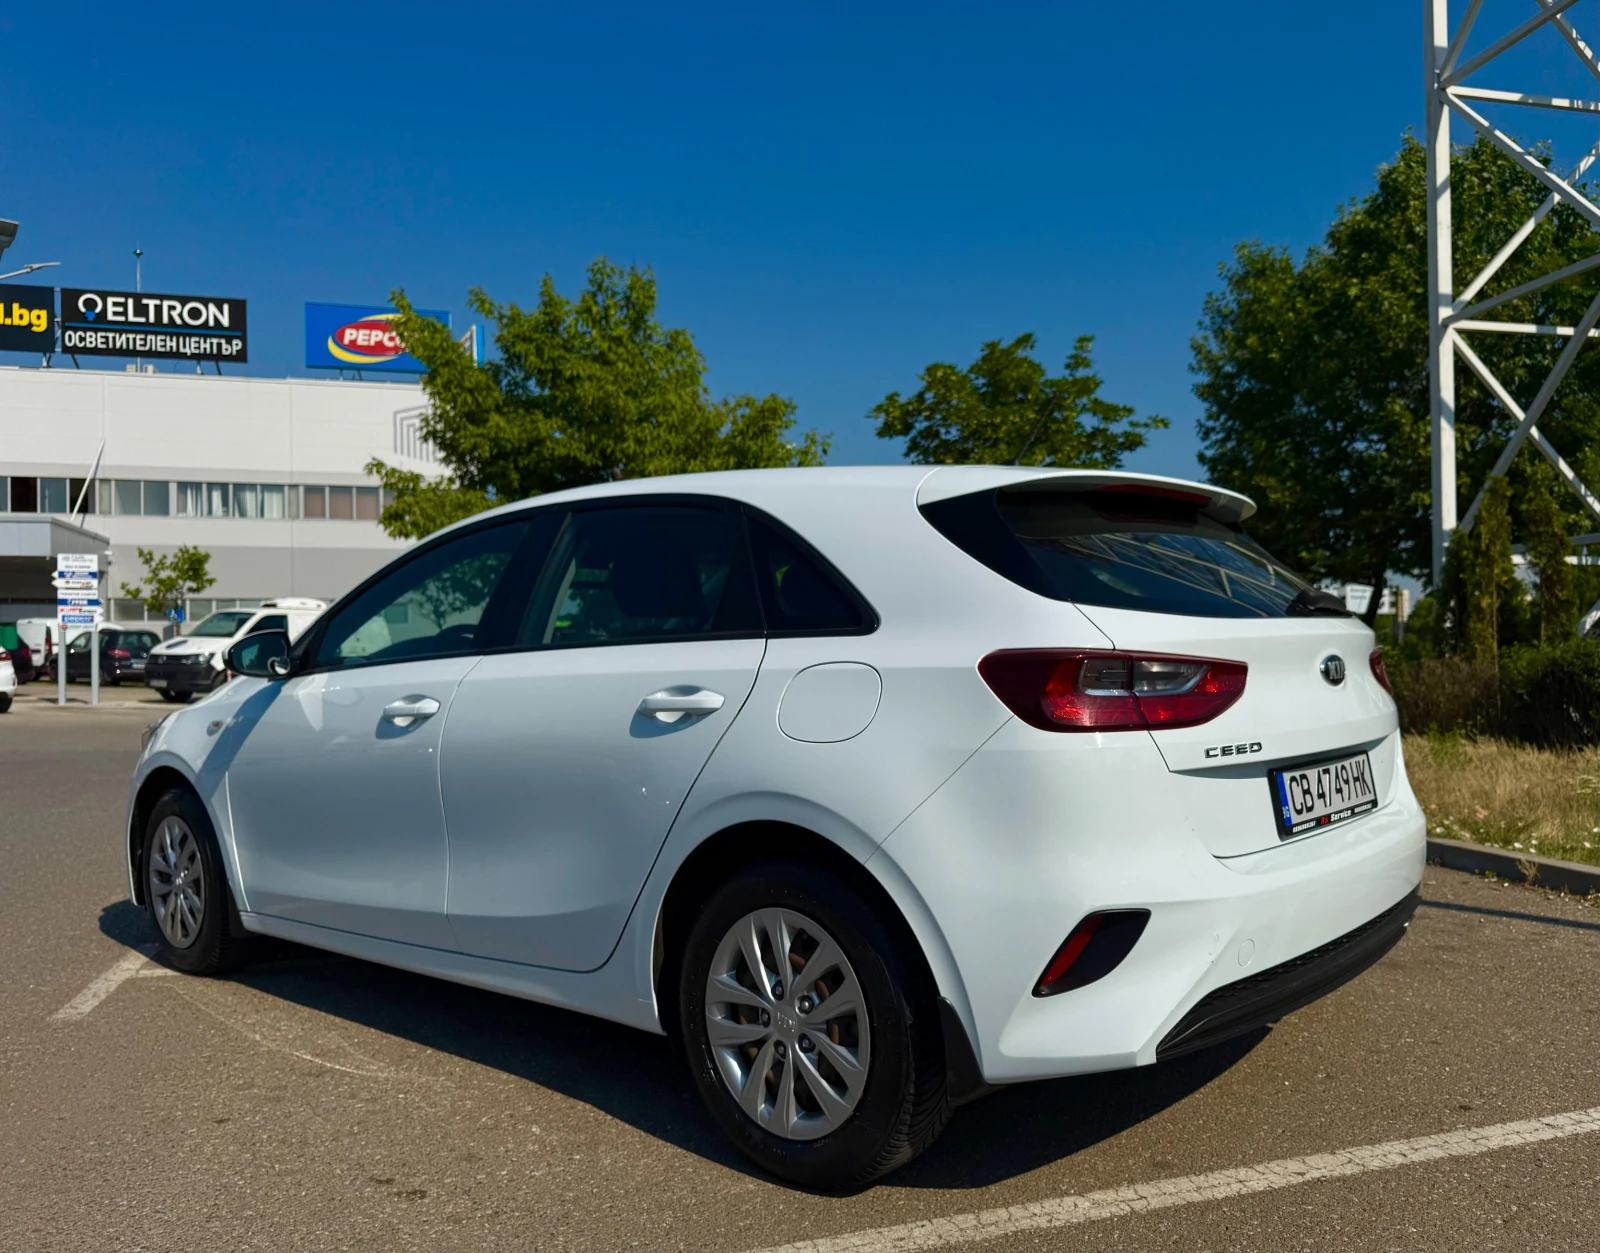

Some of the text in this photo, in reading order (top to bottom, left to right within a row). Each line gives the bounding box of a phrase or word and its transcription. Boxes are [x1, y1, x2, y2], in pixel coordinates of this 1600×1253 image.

[106, 296, 230, 328] ELTRON
[64, 330, 243, 356] ОСВЕТИТЕЛЕН ЦЕНТЪР
[1204, 741, 1263, 758] CEED
[1316, 763, 1351, 808] 4749
[1349, 758, 1372, 799] HK
